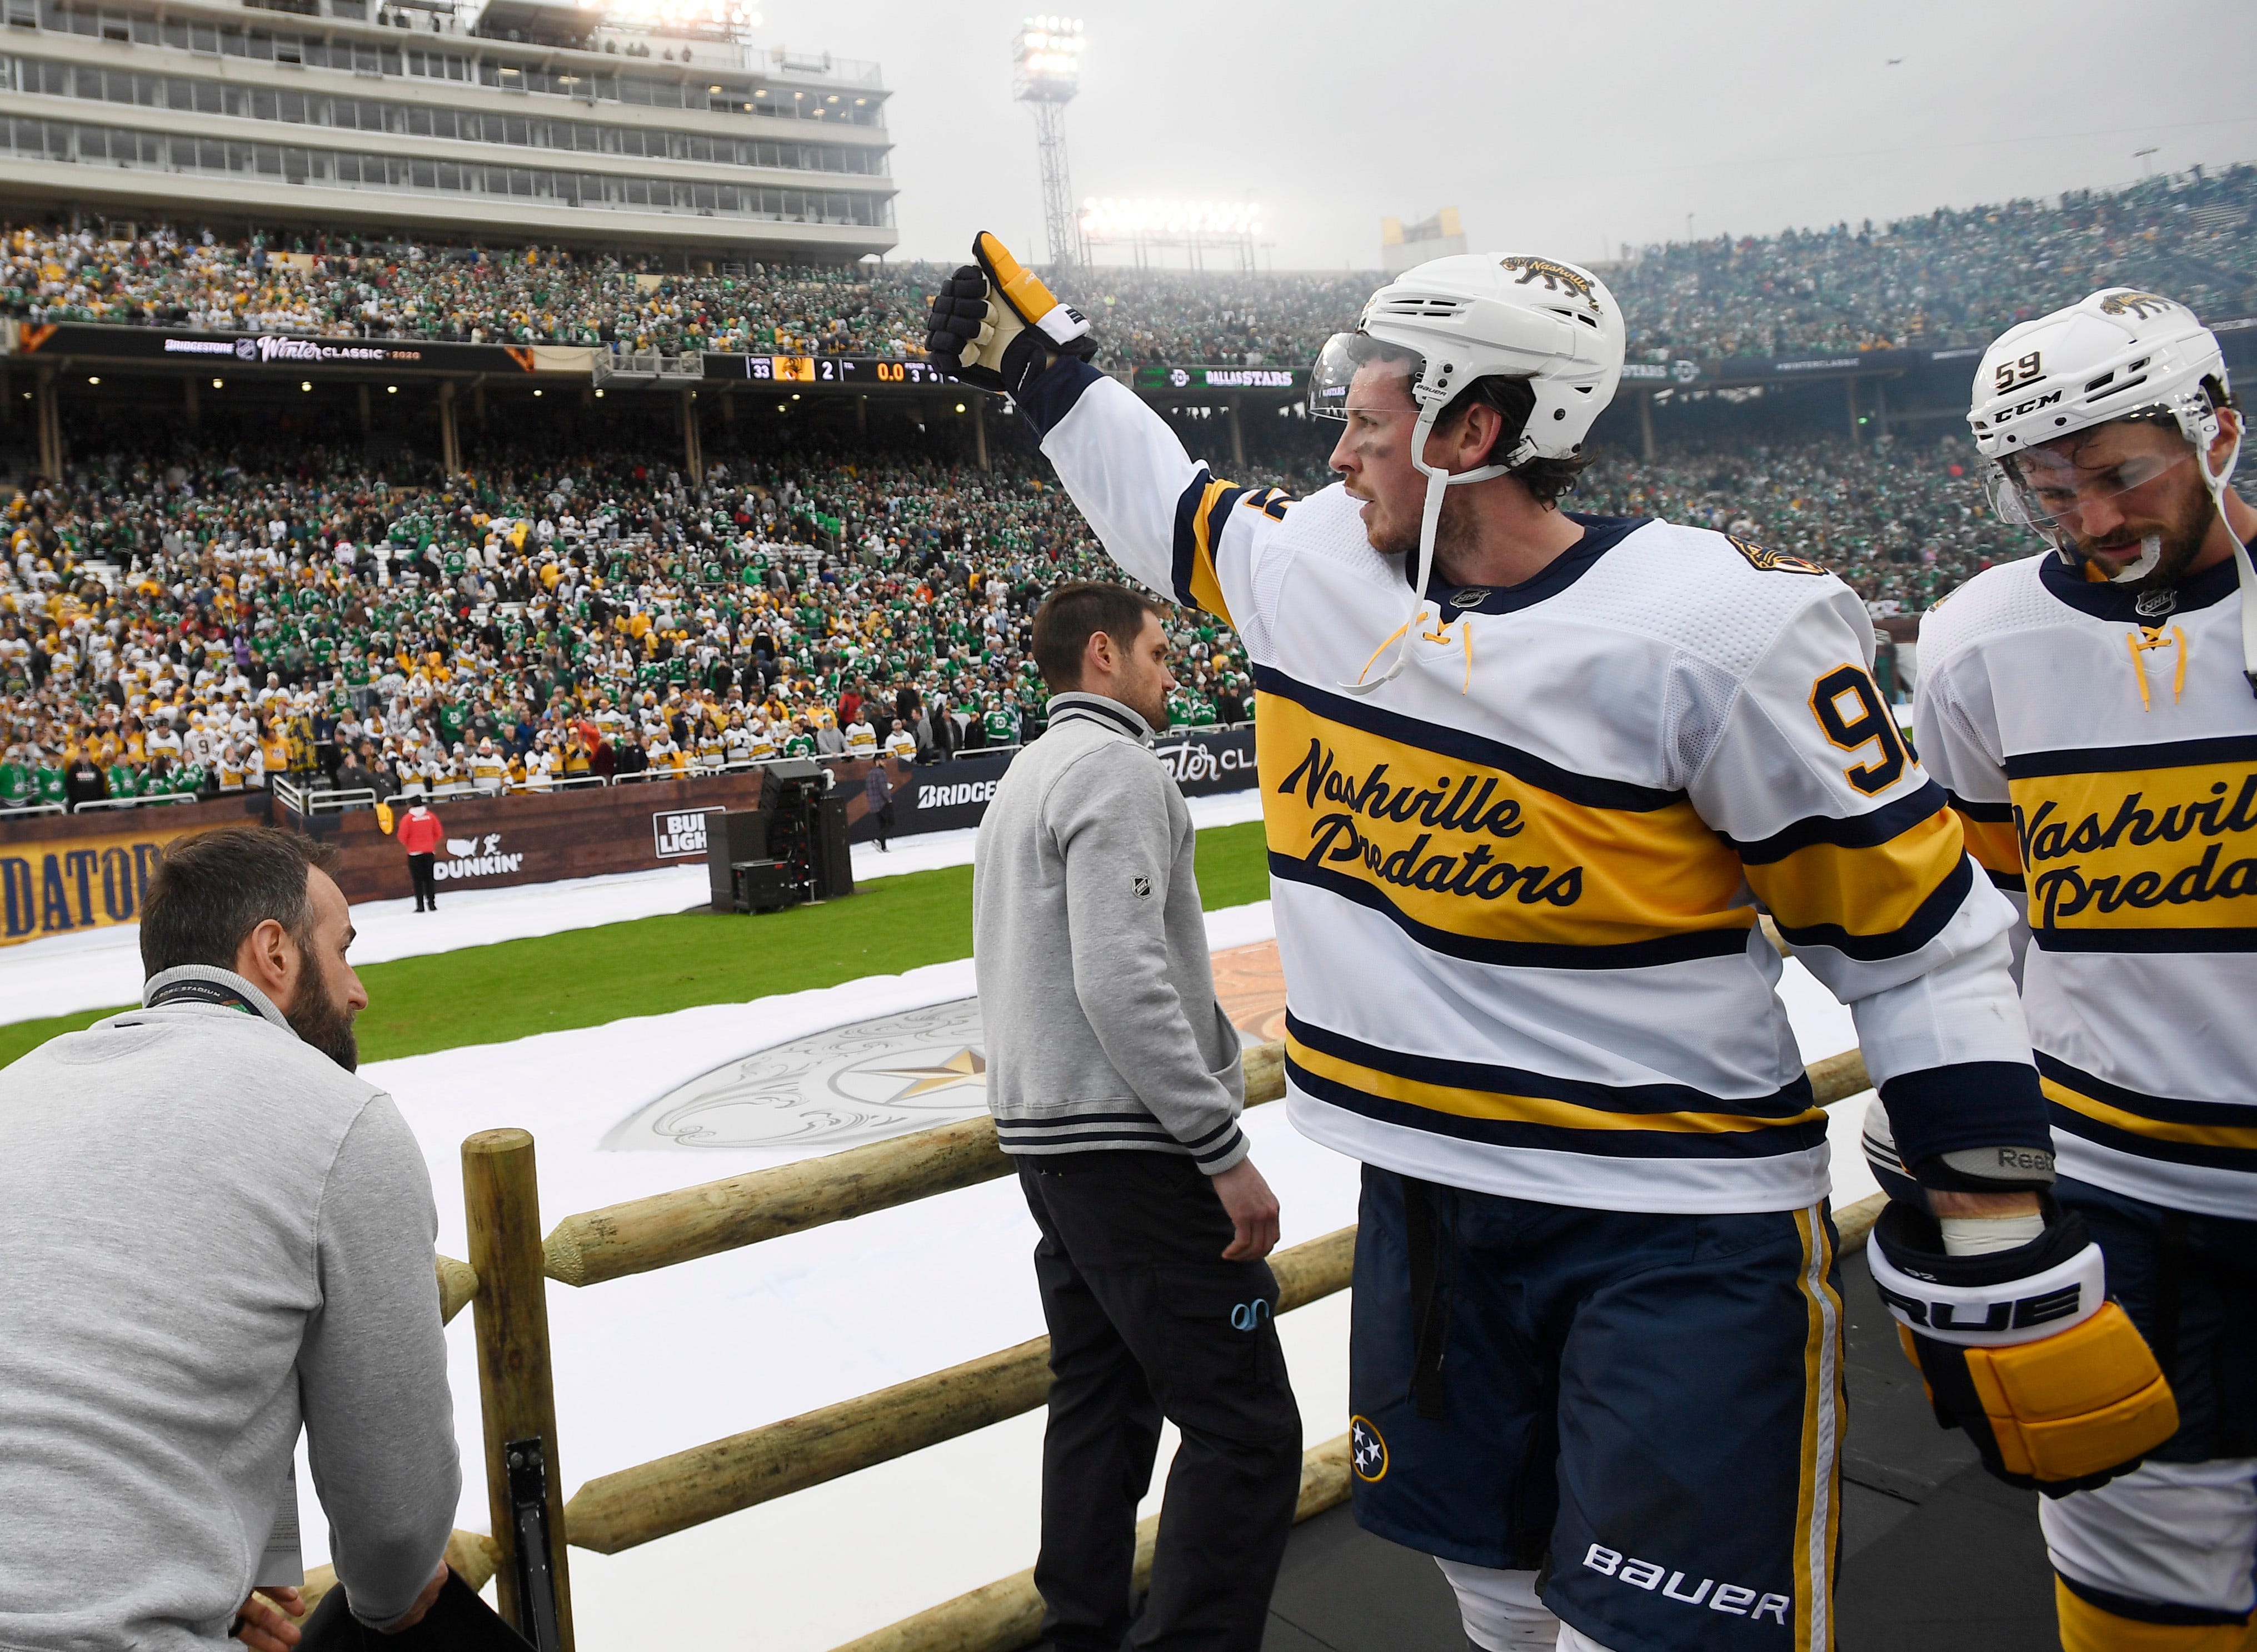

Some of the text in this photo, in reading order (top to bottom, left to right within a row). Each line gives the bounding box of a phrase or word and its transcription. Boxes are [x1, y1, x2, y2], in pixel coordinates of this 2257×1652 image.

[1529, 261, 1589, 292] Nashville
[164, 338, 234, 354] BRIDGESTONE
[256, 335, 323, 363] Winter
[322, 347, 387, 360] CLASSIC
[392, 351, 422, 360] 2020
[753, 364, 770, 379] 33
[821, 361, 834, 380] 2
[877, 362, 905, 382] 0.0
[911, 369, 920, 383] 3
[1205, 371, 1293, 387] DALLAS STARS
[1995, 351, 2041, 389] 59
[1993, 389, 2063, 423] CCM
[1807, 662, 1920, 793] 9
[1156, 740, 1259, 782] nter CL
[917, 779, 1001, 809] BRIDGE
[1277, 738, 1525, 838] Nashville
[660, 830, 707, 853] LIGH
[433, 852, 524, 882] DUNKIN'
[1304, 813, 1583, 907] Predators
[181, 985, 221, 998] STADIUM
[1998, 1147, 2053, 1172] Reeb
[1876, 1278, 2081, 1331] RUE
